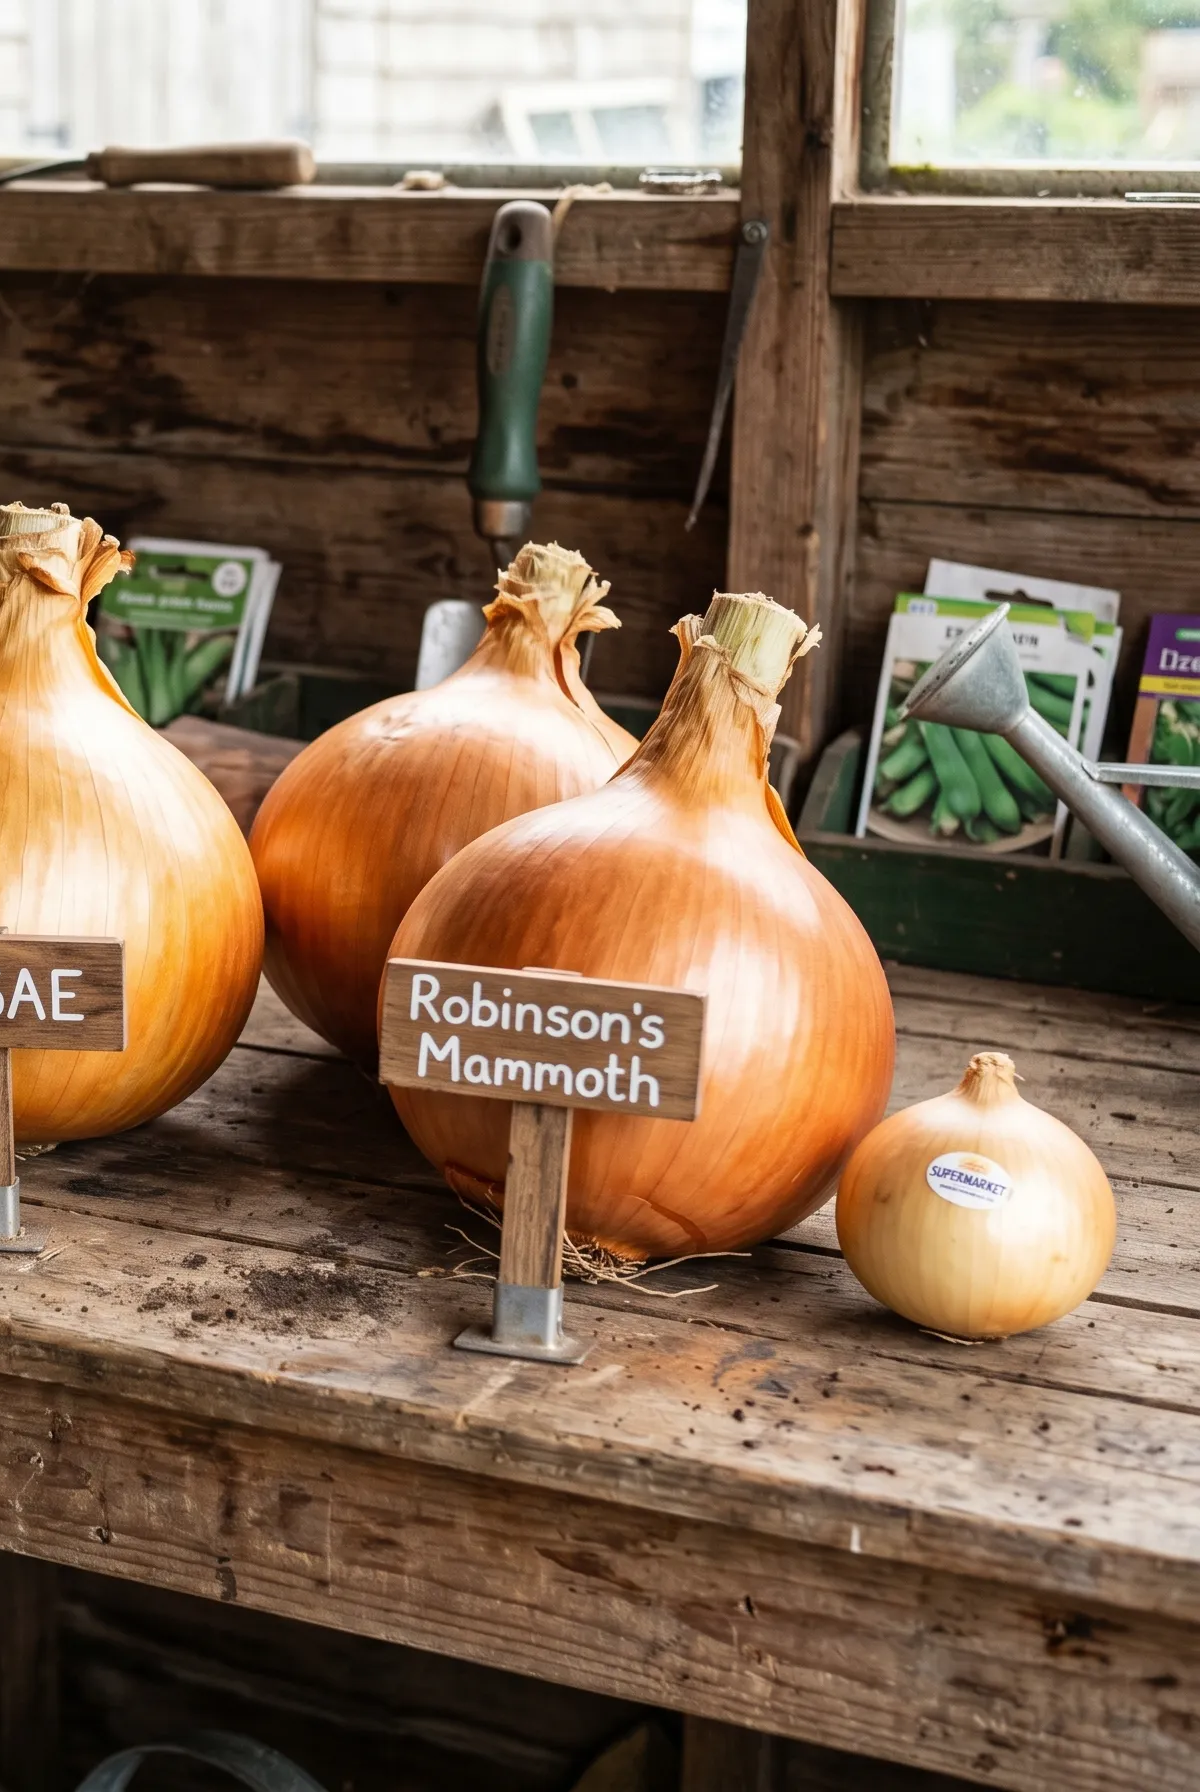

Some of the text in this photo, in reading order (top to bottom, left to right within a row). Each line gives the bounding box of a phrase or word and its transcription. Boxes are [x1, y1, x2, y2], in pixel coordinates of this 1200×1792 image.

[410, 973, 665, 1049] Robinson's
[417, 1032, 660, 1107] Mammoth
[929, 1165, 1007, 1197] SUPERMARKET
